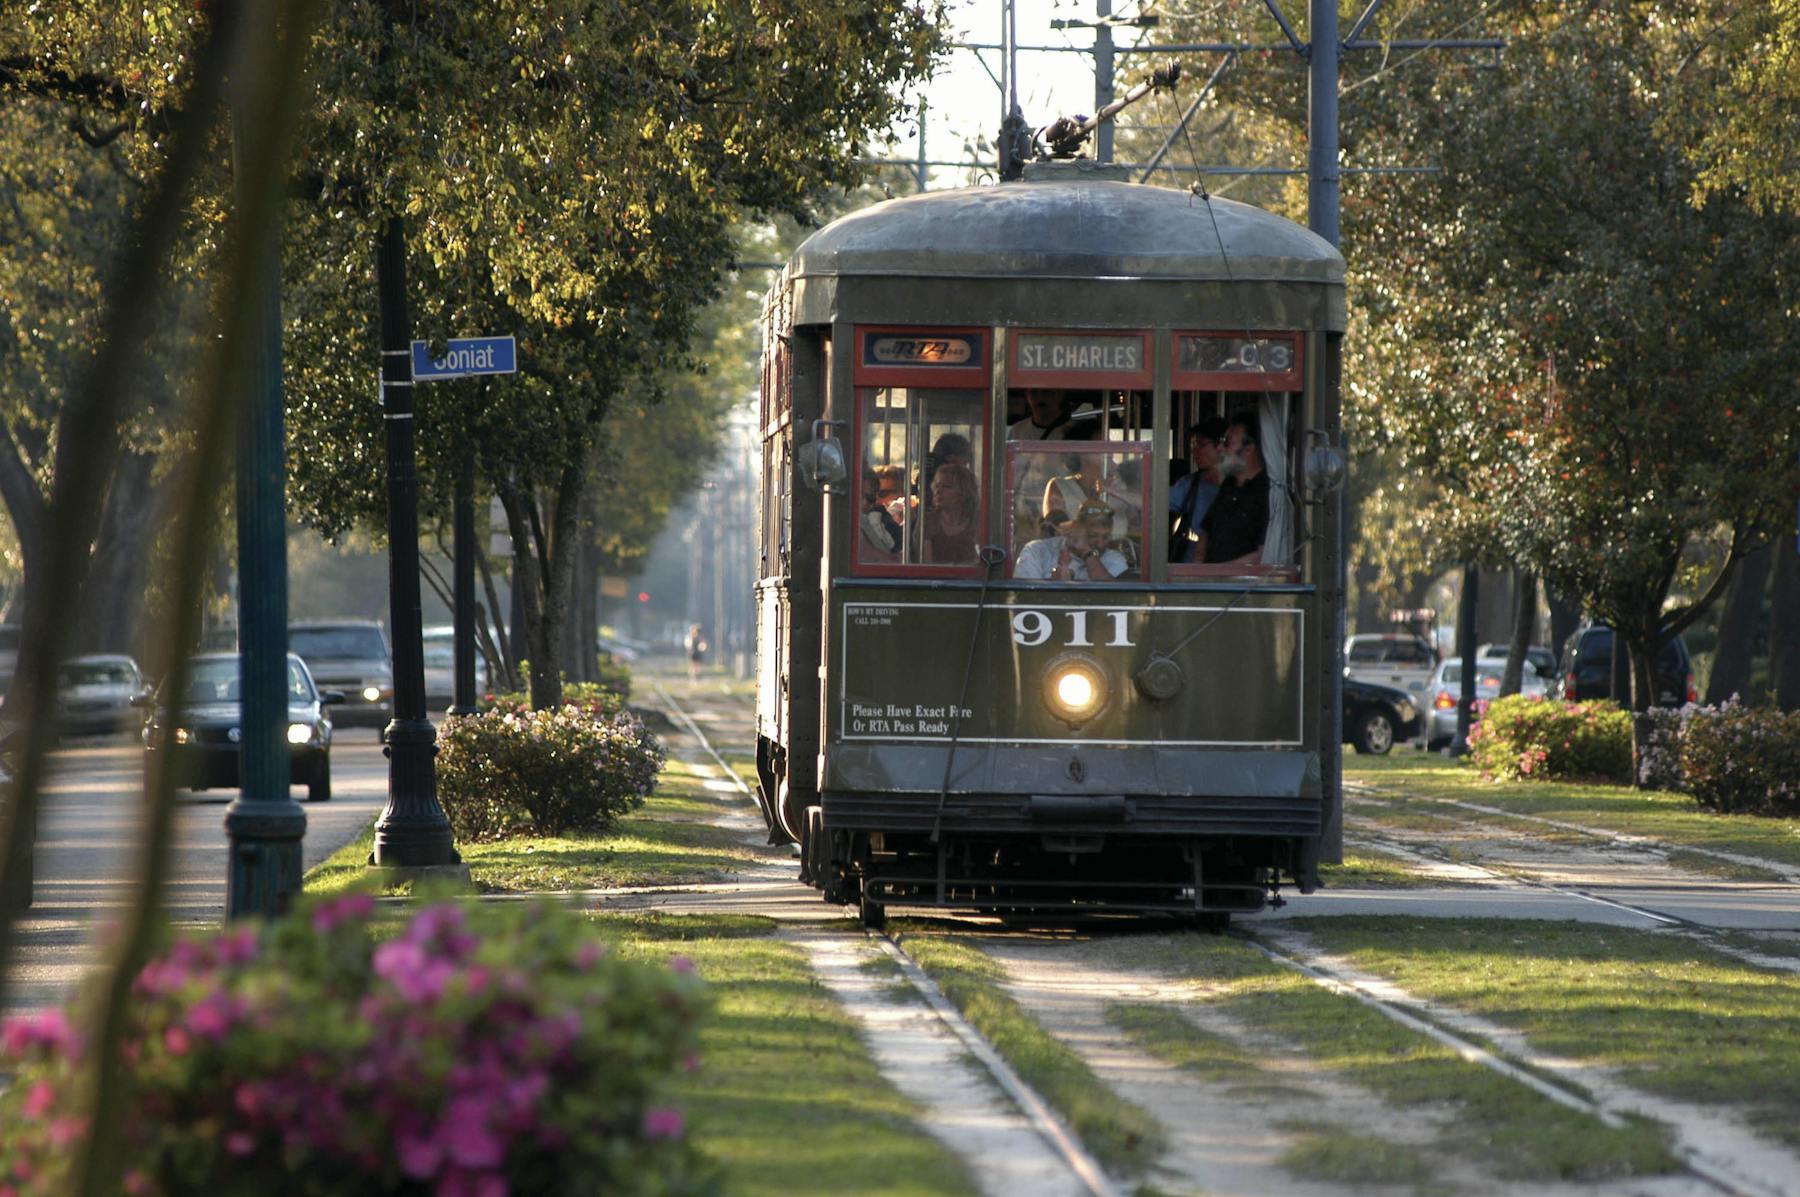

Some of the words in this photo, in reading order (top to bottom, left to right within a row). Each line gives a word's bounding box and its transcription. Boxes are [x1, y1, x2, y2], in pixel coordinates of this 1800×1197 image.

[1023, 345, 1048, 367] ST.
[1052, 345, 1136, 368] CHARLES
[1013, 610, 1136, 646] 911
[852, 704, 882, 717] Please
[887, 704, 912, 717] Have
[915, 705, 945, 718] Exact
[853, 720, 866, 733] Or
[869, 720, 890, 733] RTA
[894, 720, 915, 733] Pass
[918, 720, 950, 735] Ready
